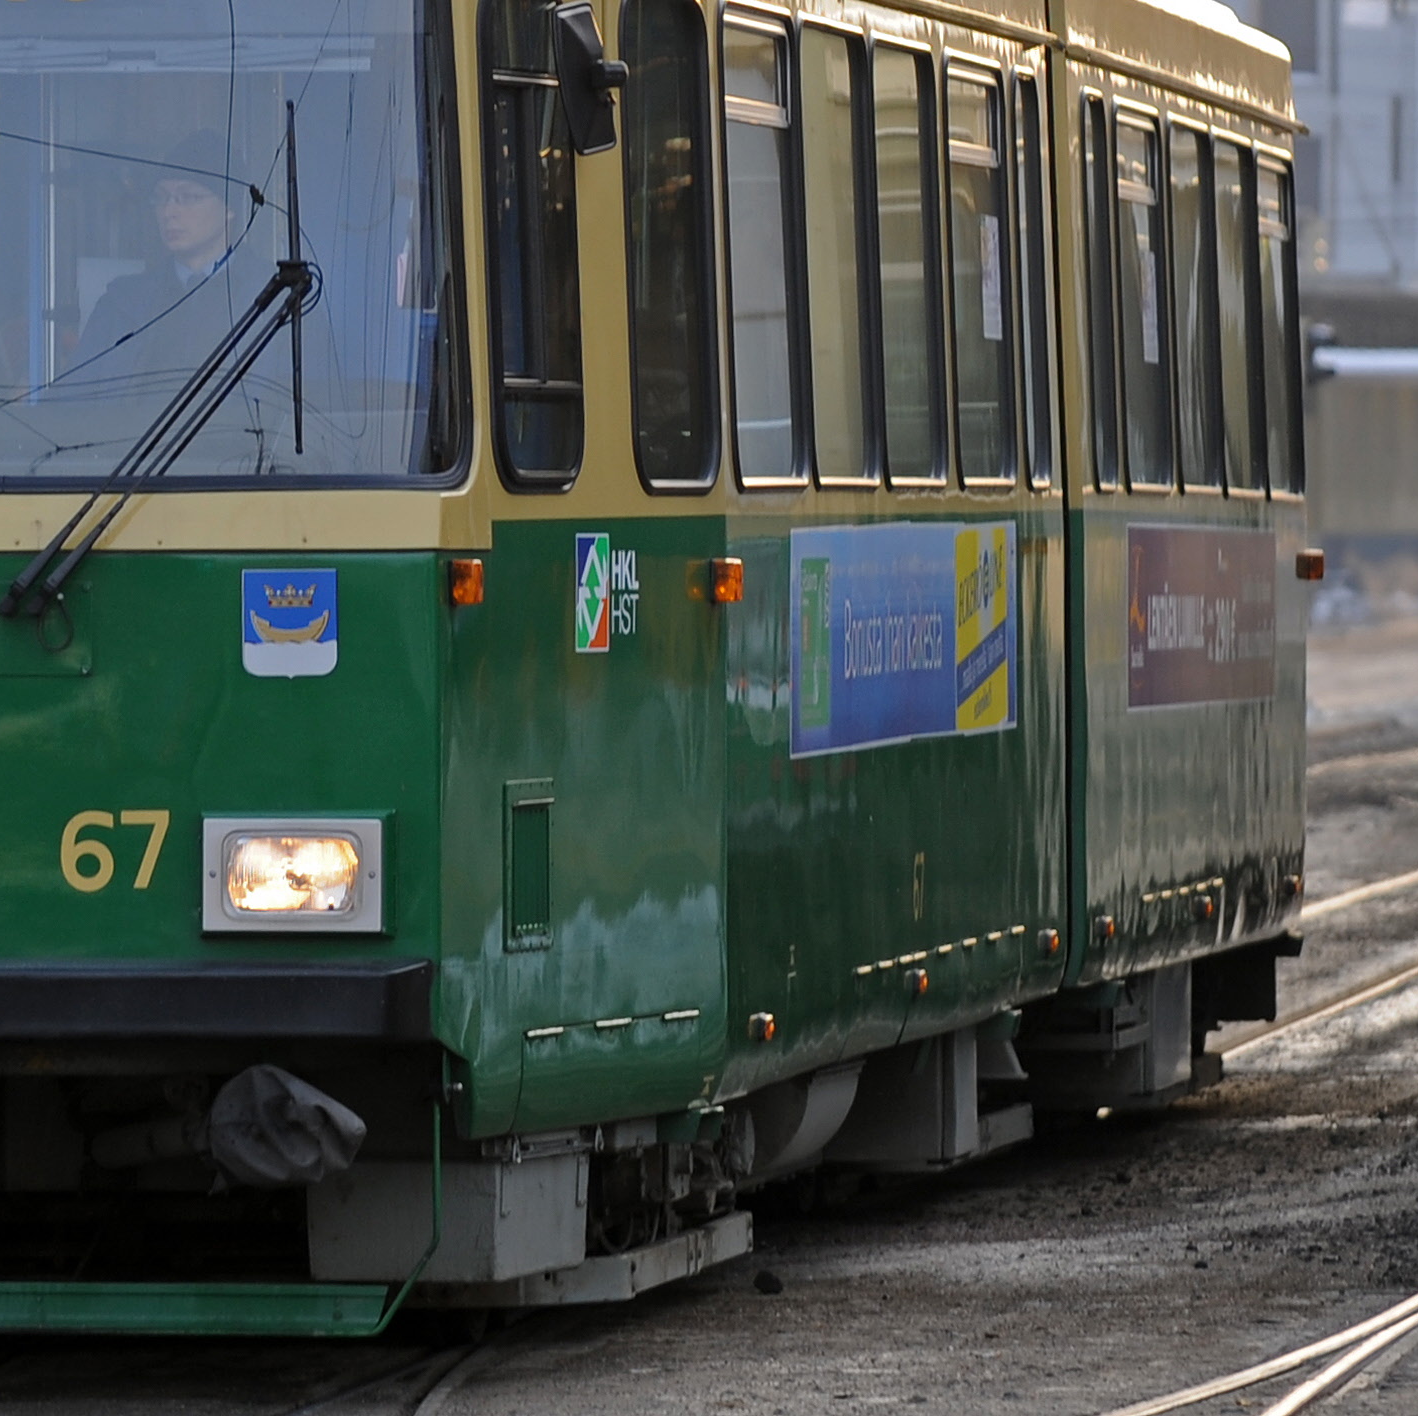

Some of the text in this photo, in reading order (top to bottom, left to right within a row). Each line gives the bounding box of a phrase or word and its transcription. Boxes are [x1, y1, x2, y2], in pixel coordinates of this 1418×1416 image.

[611, 549, 640, 591] HKL
[611, 593, 640, 635] HST
[60, 810, 170, 893] 67
